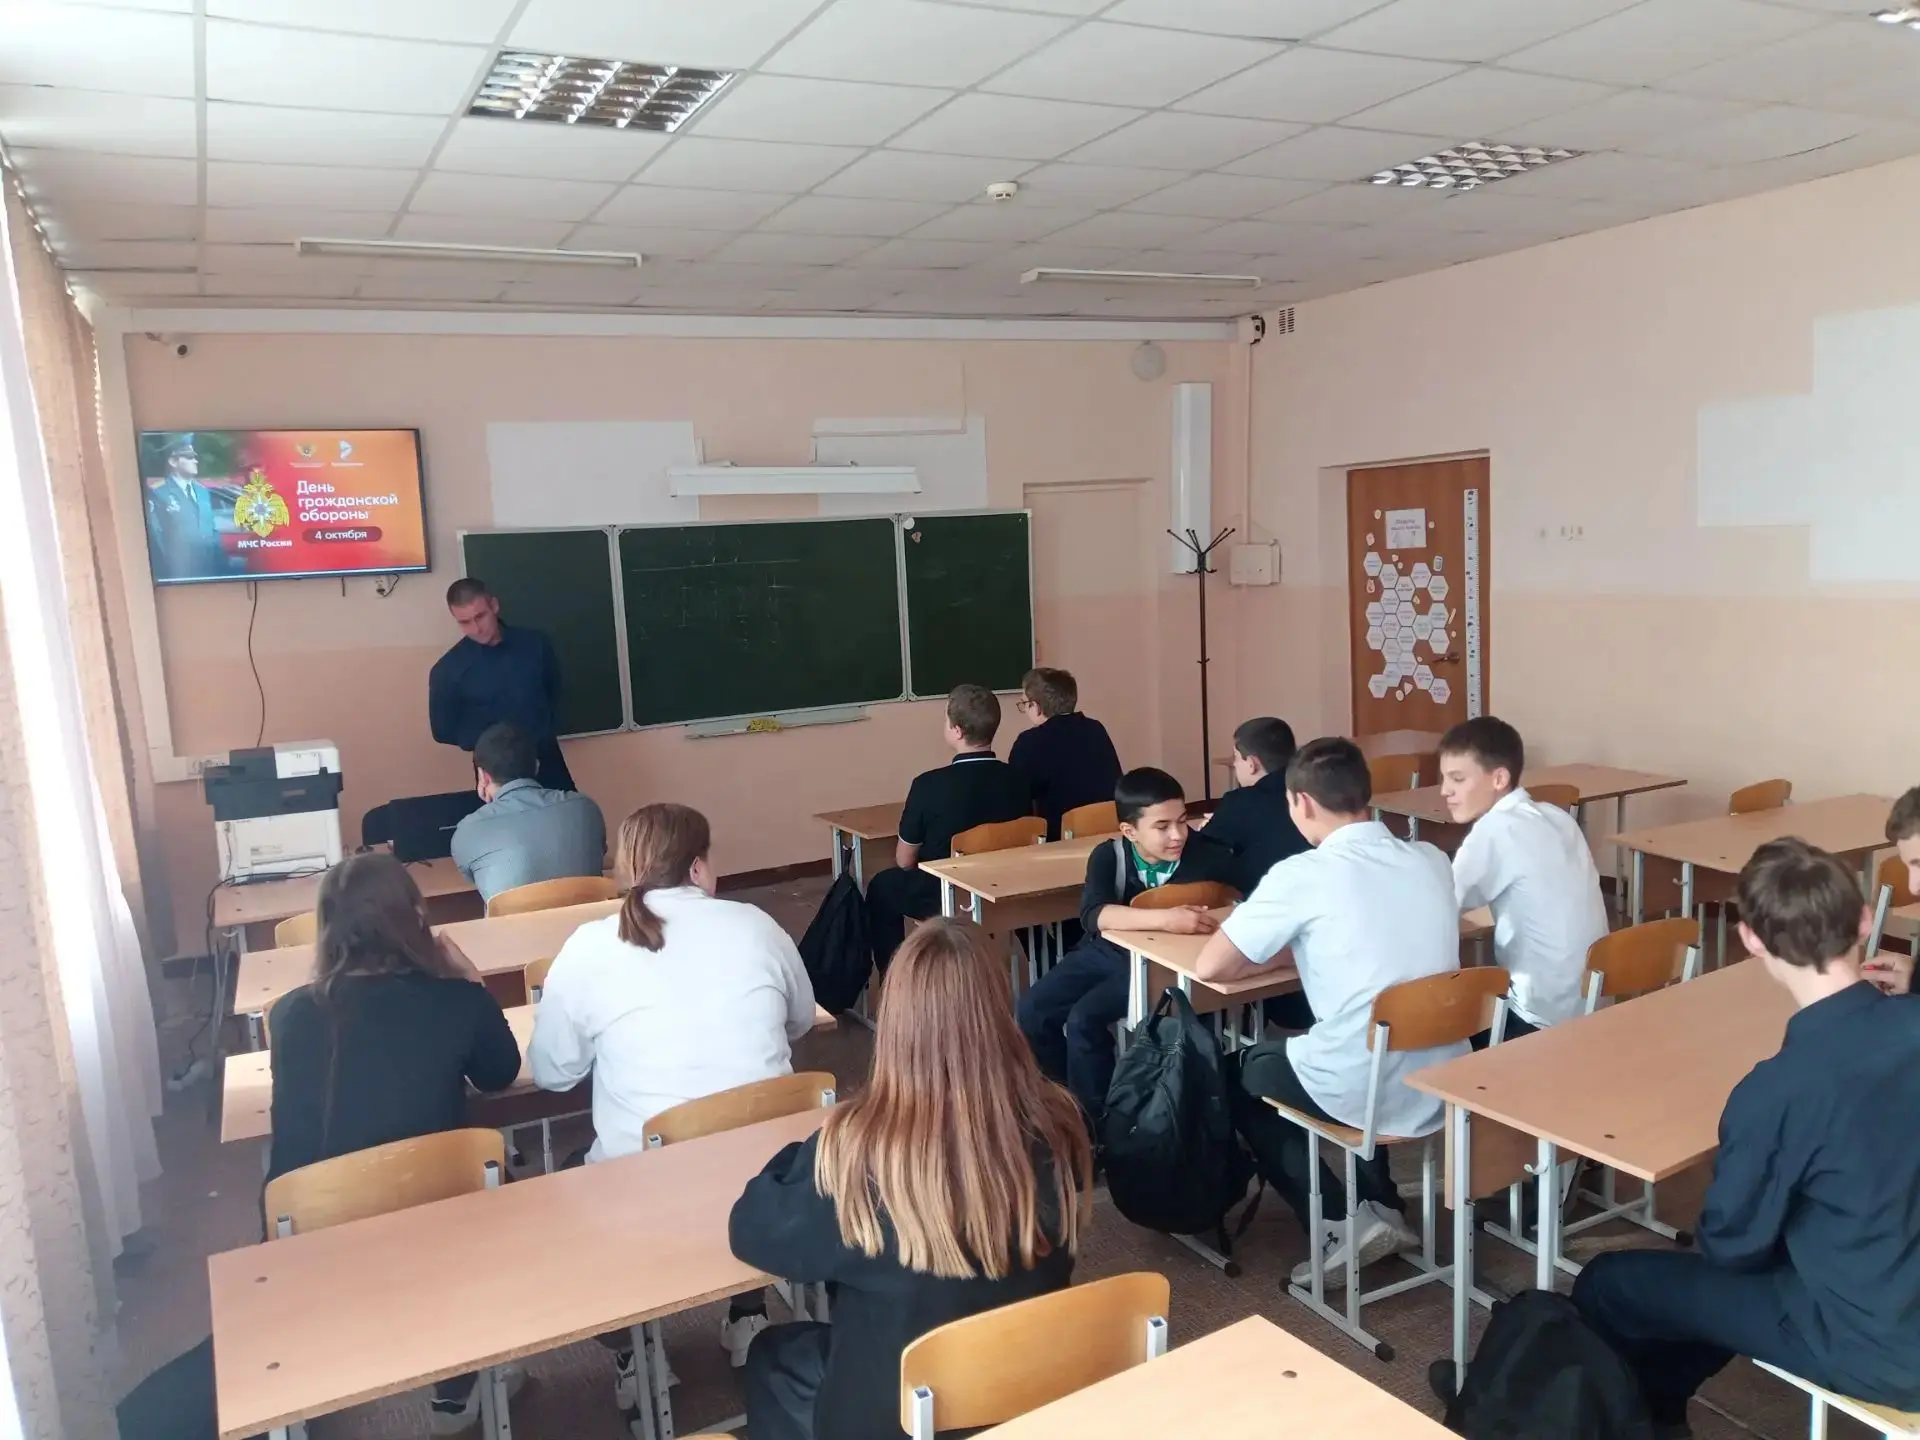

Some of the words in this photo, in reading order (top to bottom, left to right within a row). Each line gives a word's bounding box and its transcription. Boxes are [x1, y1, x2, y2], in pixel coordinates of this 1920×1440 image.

[297, 480, 335, 495] День
[298, 493, 399, 510] гражданской
[300, 508, 369, 523] обороны
[315, 531, 321, 540] 4
[325, 530, 367, 541] октября
[237, 540, 259, 548] МЧС
[260, 539, 292, 548] России
